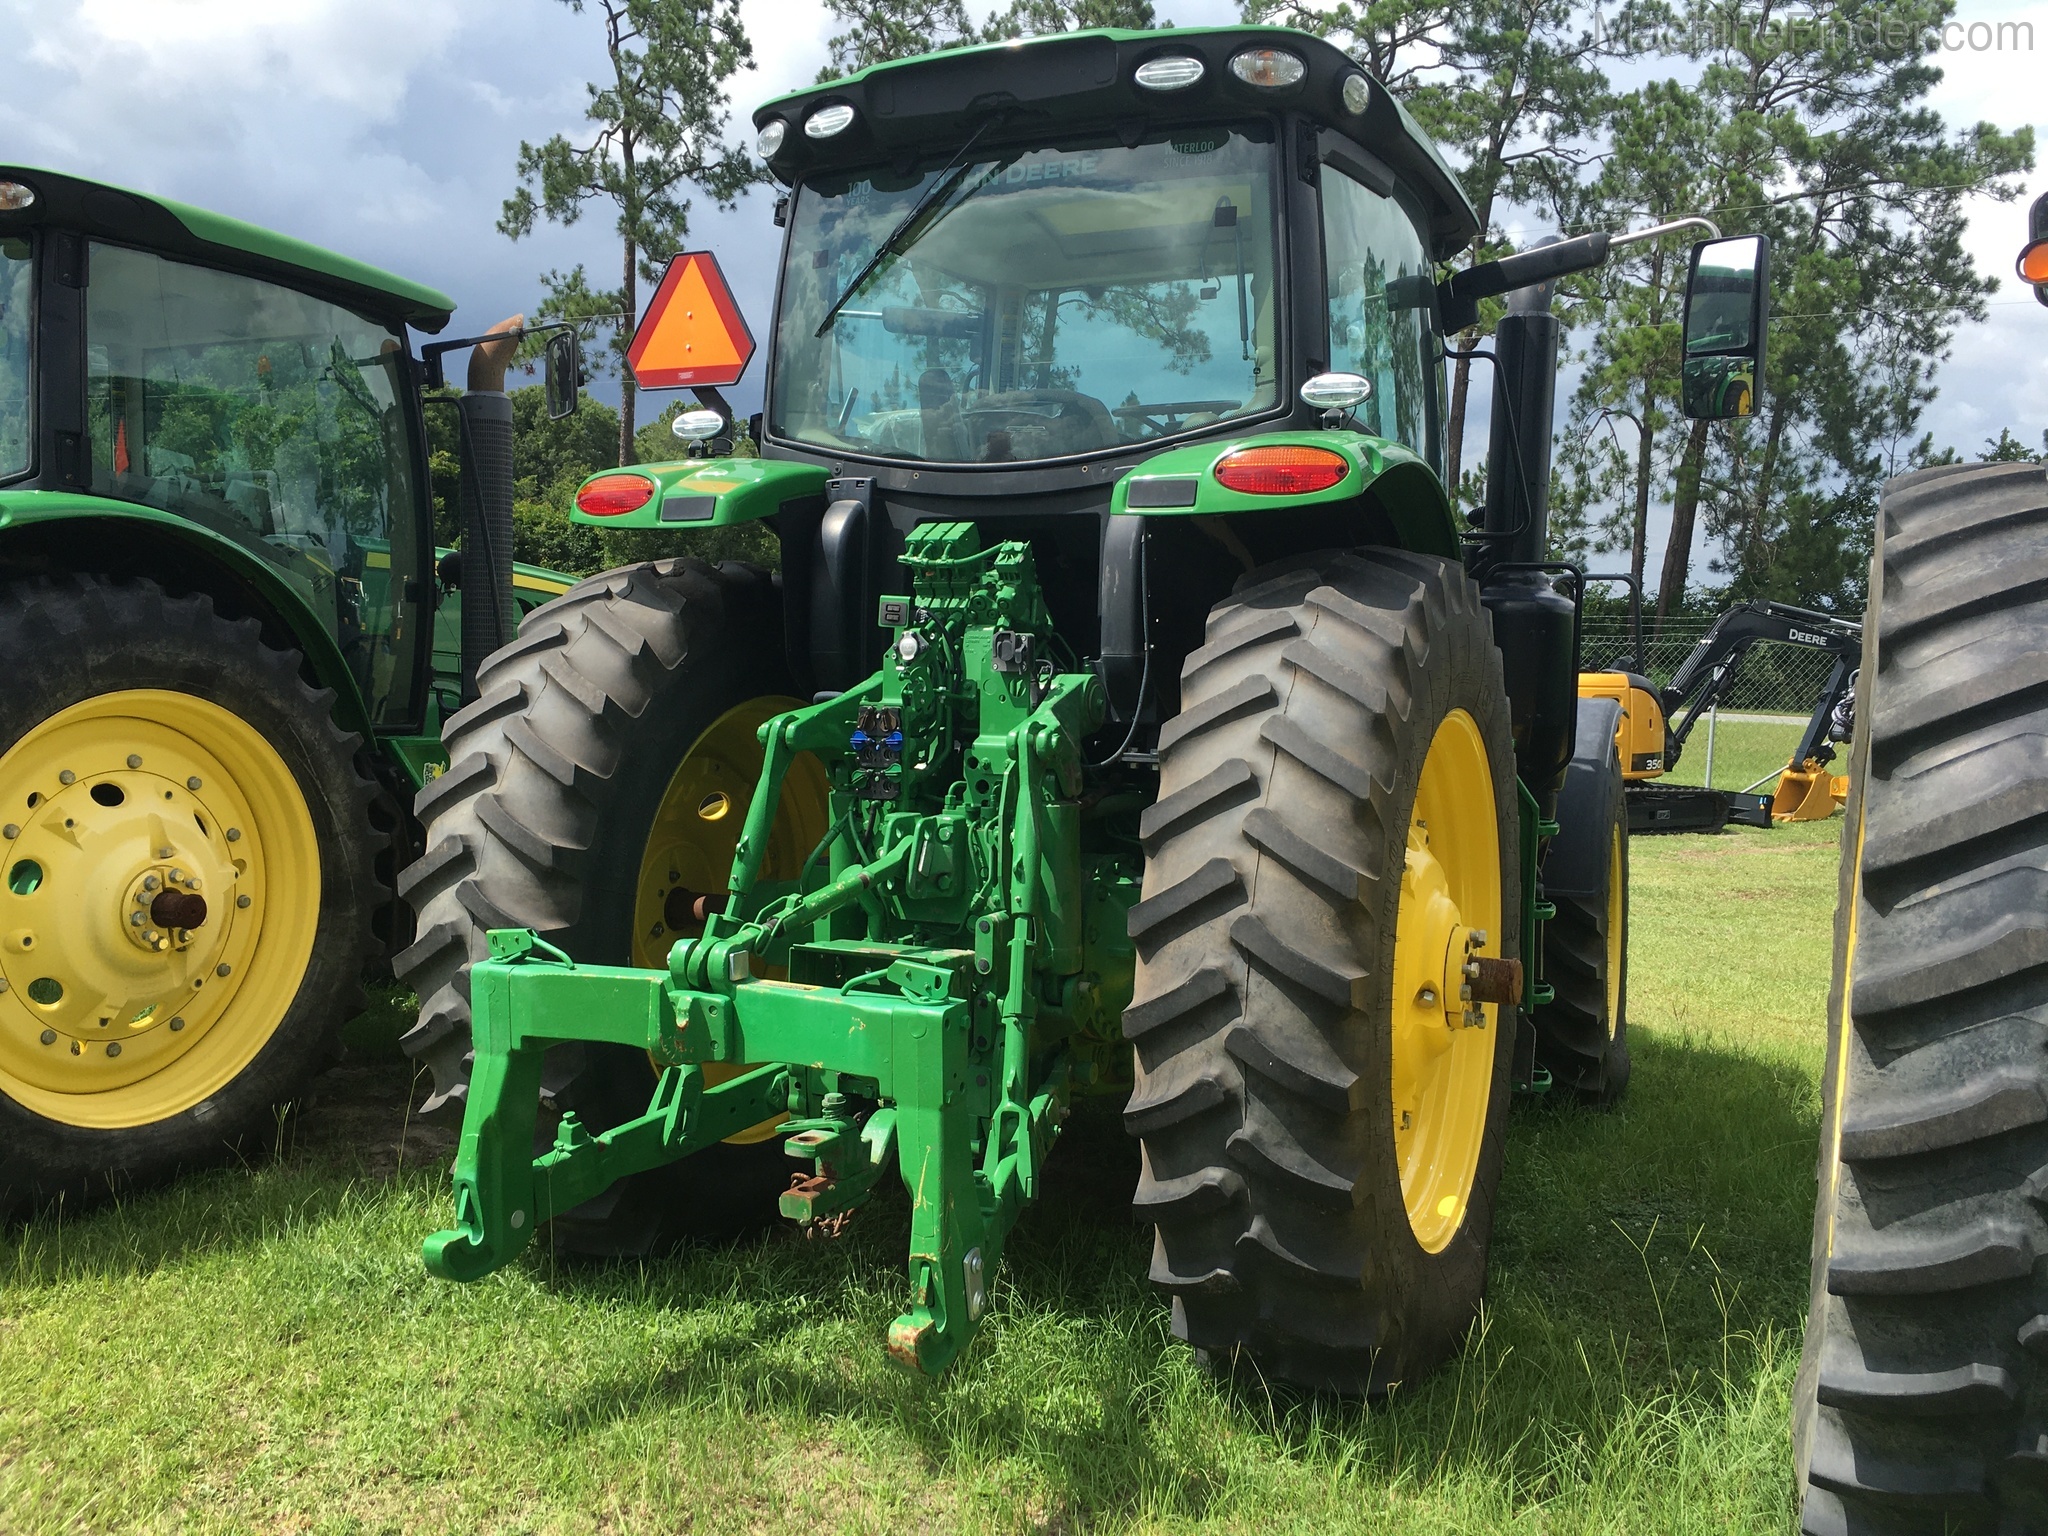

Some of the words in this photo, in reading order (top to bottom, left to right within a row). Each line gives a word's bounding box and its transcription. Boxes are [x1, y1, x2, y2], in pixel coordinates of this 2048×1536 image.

[1164, 141, 1215, 154] WATERLOO
[1164, 156, 1190, 168] SINCE
[1194, 154, 1213, 166] 1918
[1006, 157, 1098, 183] DEERE
[848, 179, 871, 197] 100
[847, 196, 870, 206] YEARS
[1789, 628, 1828, 646] DEERE
[1646, 759, 1662, 770] 35G
